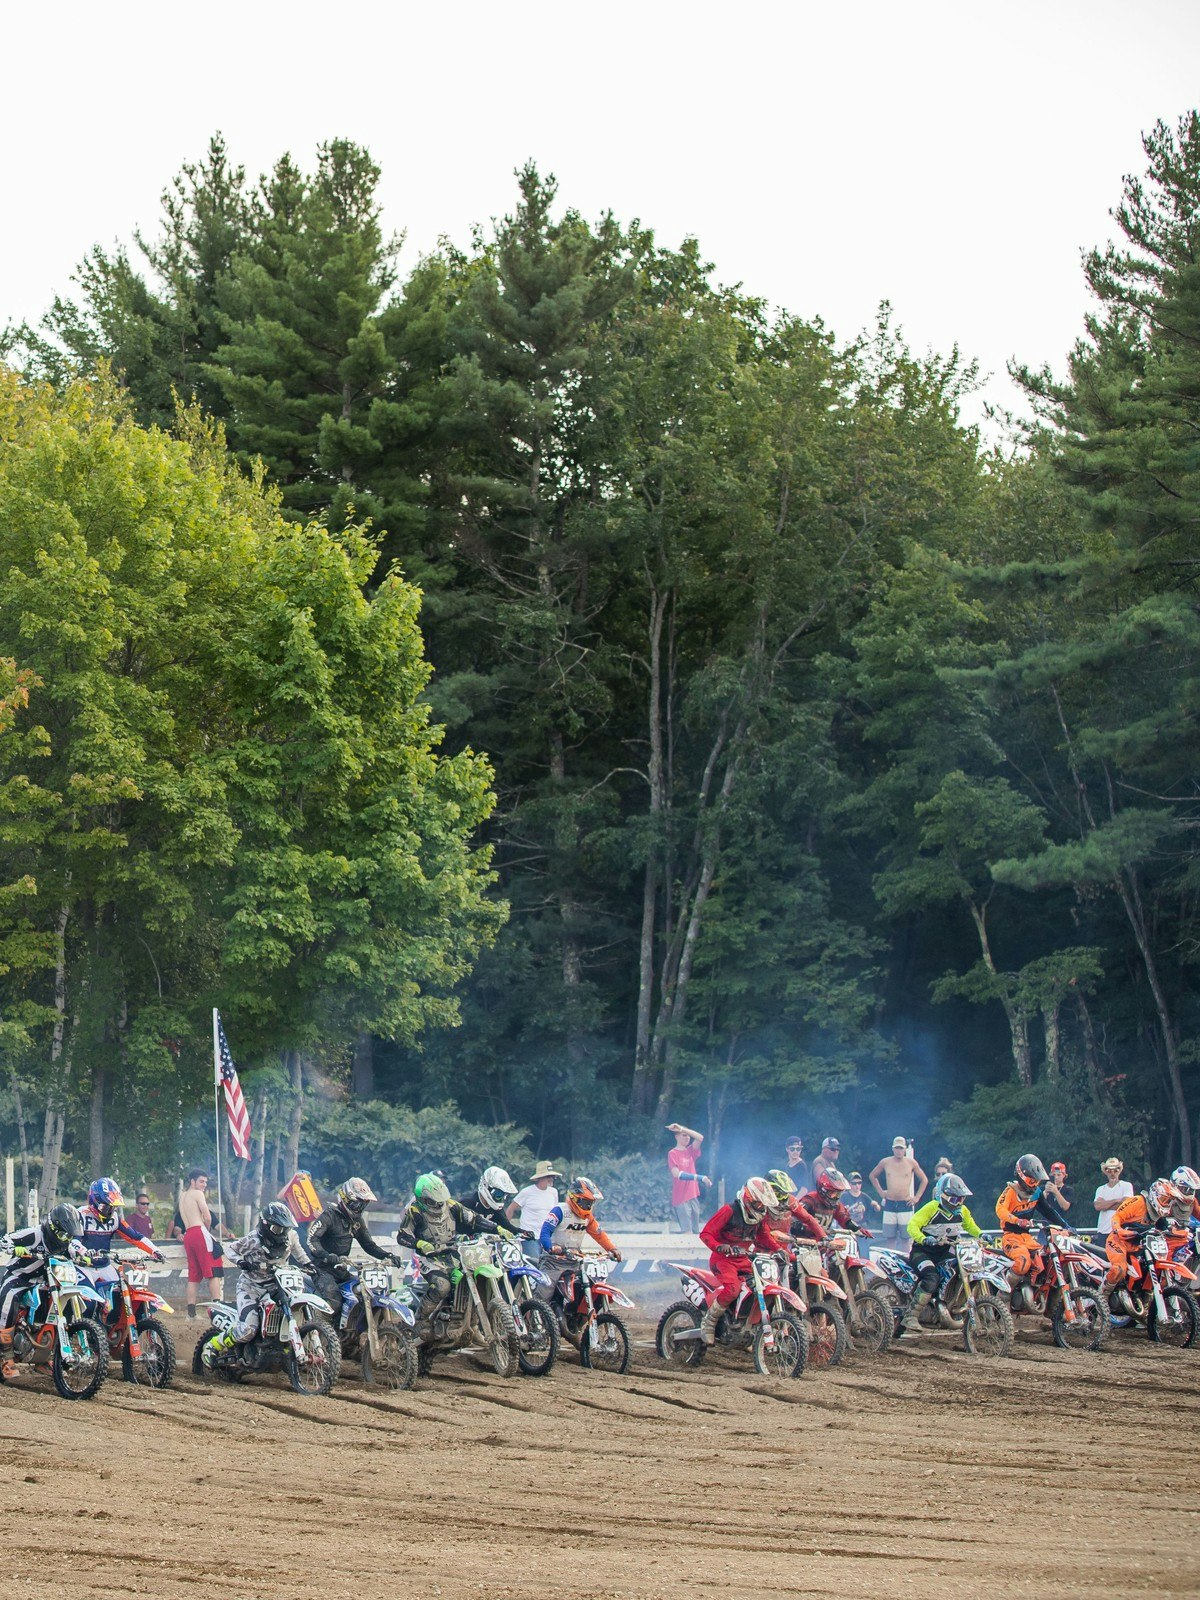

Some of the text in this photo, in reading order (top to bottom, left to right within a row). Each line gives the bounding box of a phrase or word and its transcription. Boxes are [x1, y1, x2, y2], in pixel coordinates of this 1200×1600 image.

[85, 1216, 115, 1231] FXR
[960, 1247, 982, 1265] 254
[125, 1269, 149, 1286] 127
[365, 1270, 388, 1289] 55
[586, 1264, 608, 1278] 419
[682, 1279, 706, 1307] 38
